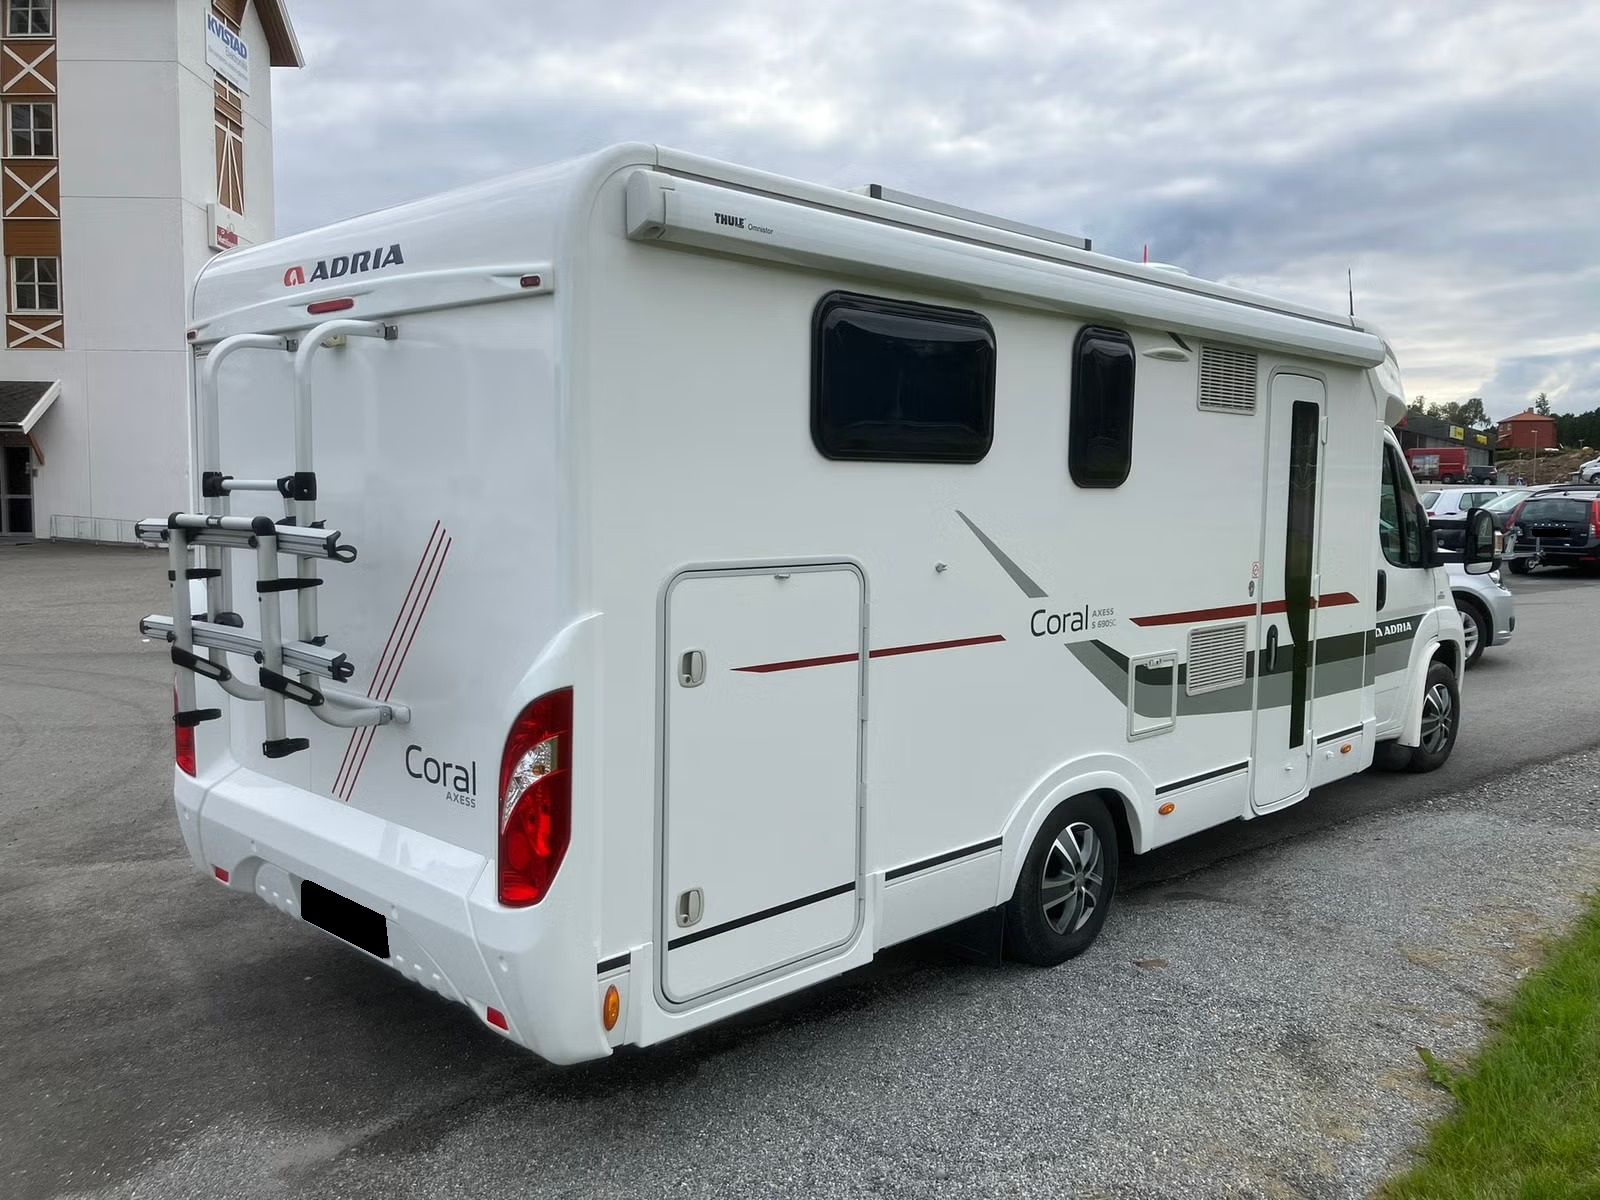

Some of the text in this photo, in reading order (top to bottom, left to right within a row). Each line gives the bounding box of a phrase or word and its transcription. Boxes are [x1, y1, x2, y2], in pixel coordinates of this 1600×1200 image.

[207, 13, 248, 60] KVISTAD
[714, 212, 745, 229] THULE
[309, 243, 405, 283] ADRIA
[1030, 604, 1089, 637] Coral
[1091, 607, 1114, 618] AXESS
[1383, 621, 1412, 636] ADRIA
[405, 744, 477, 797] Coral
[445, 791, 477, 809] AXESS
